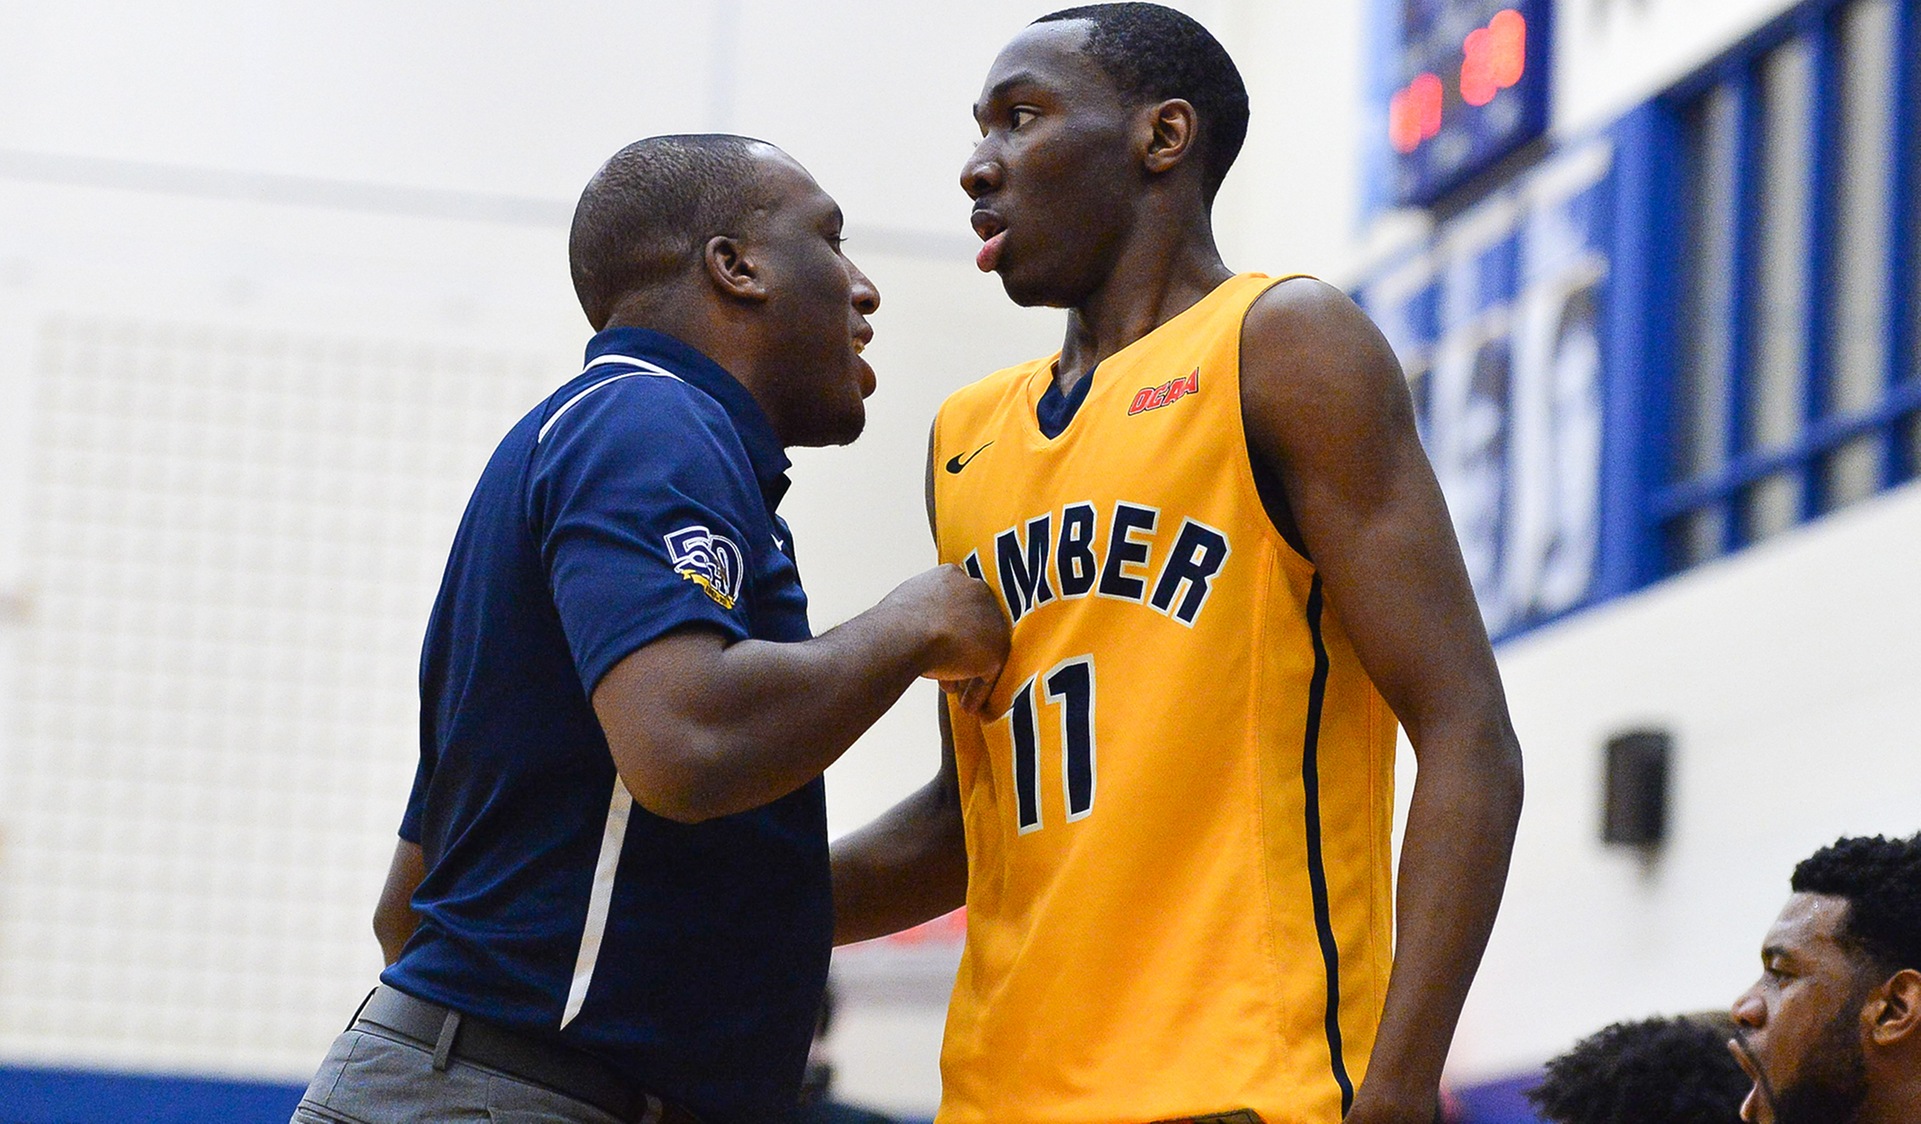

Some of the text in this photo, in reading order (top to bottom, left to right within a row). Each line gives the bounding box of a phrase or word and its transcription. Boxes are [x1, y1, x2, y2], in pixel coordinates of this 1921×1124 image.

[1128, 367, 1199, 416] OCAA
[663, 525, 744, 603] 50
[964, 500, 1232, 628] MBER
[1006, 653, 1097, 836] 11
